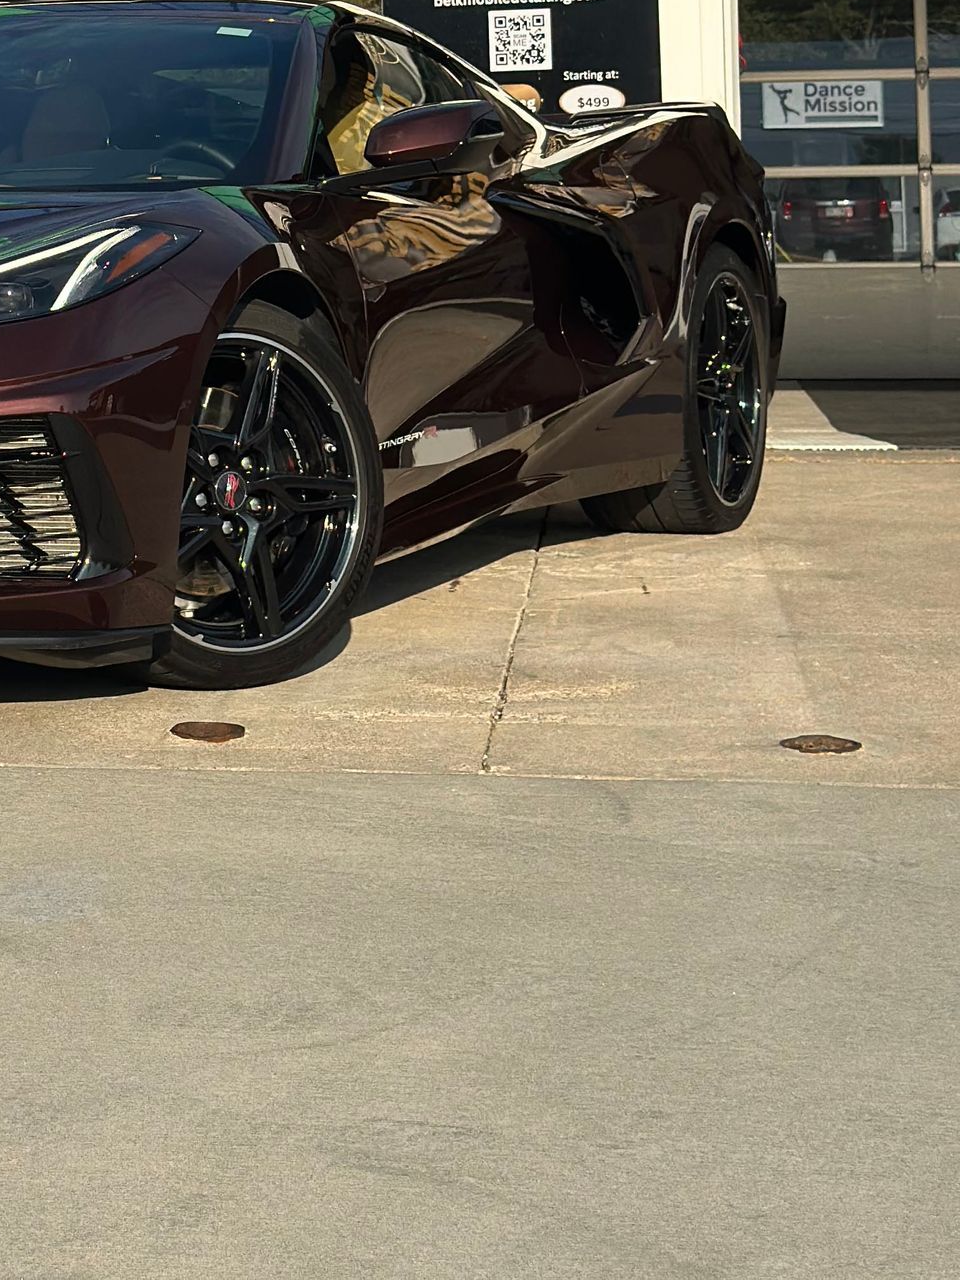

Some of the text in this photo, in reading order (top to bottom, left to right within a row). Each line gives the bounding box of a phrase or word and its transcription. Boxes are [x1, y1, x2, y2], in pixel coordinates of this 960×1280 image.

[513, 39, 527, 47] ME
[563, 70, 619, 81] Starting at:
[803, 83, 866, 97] Dance
[577, 97, 610, 108] $499
[804, 97, 878, 112] Mission
